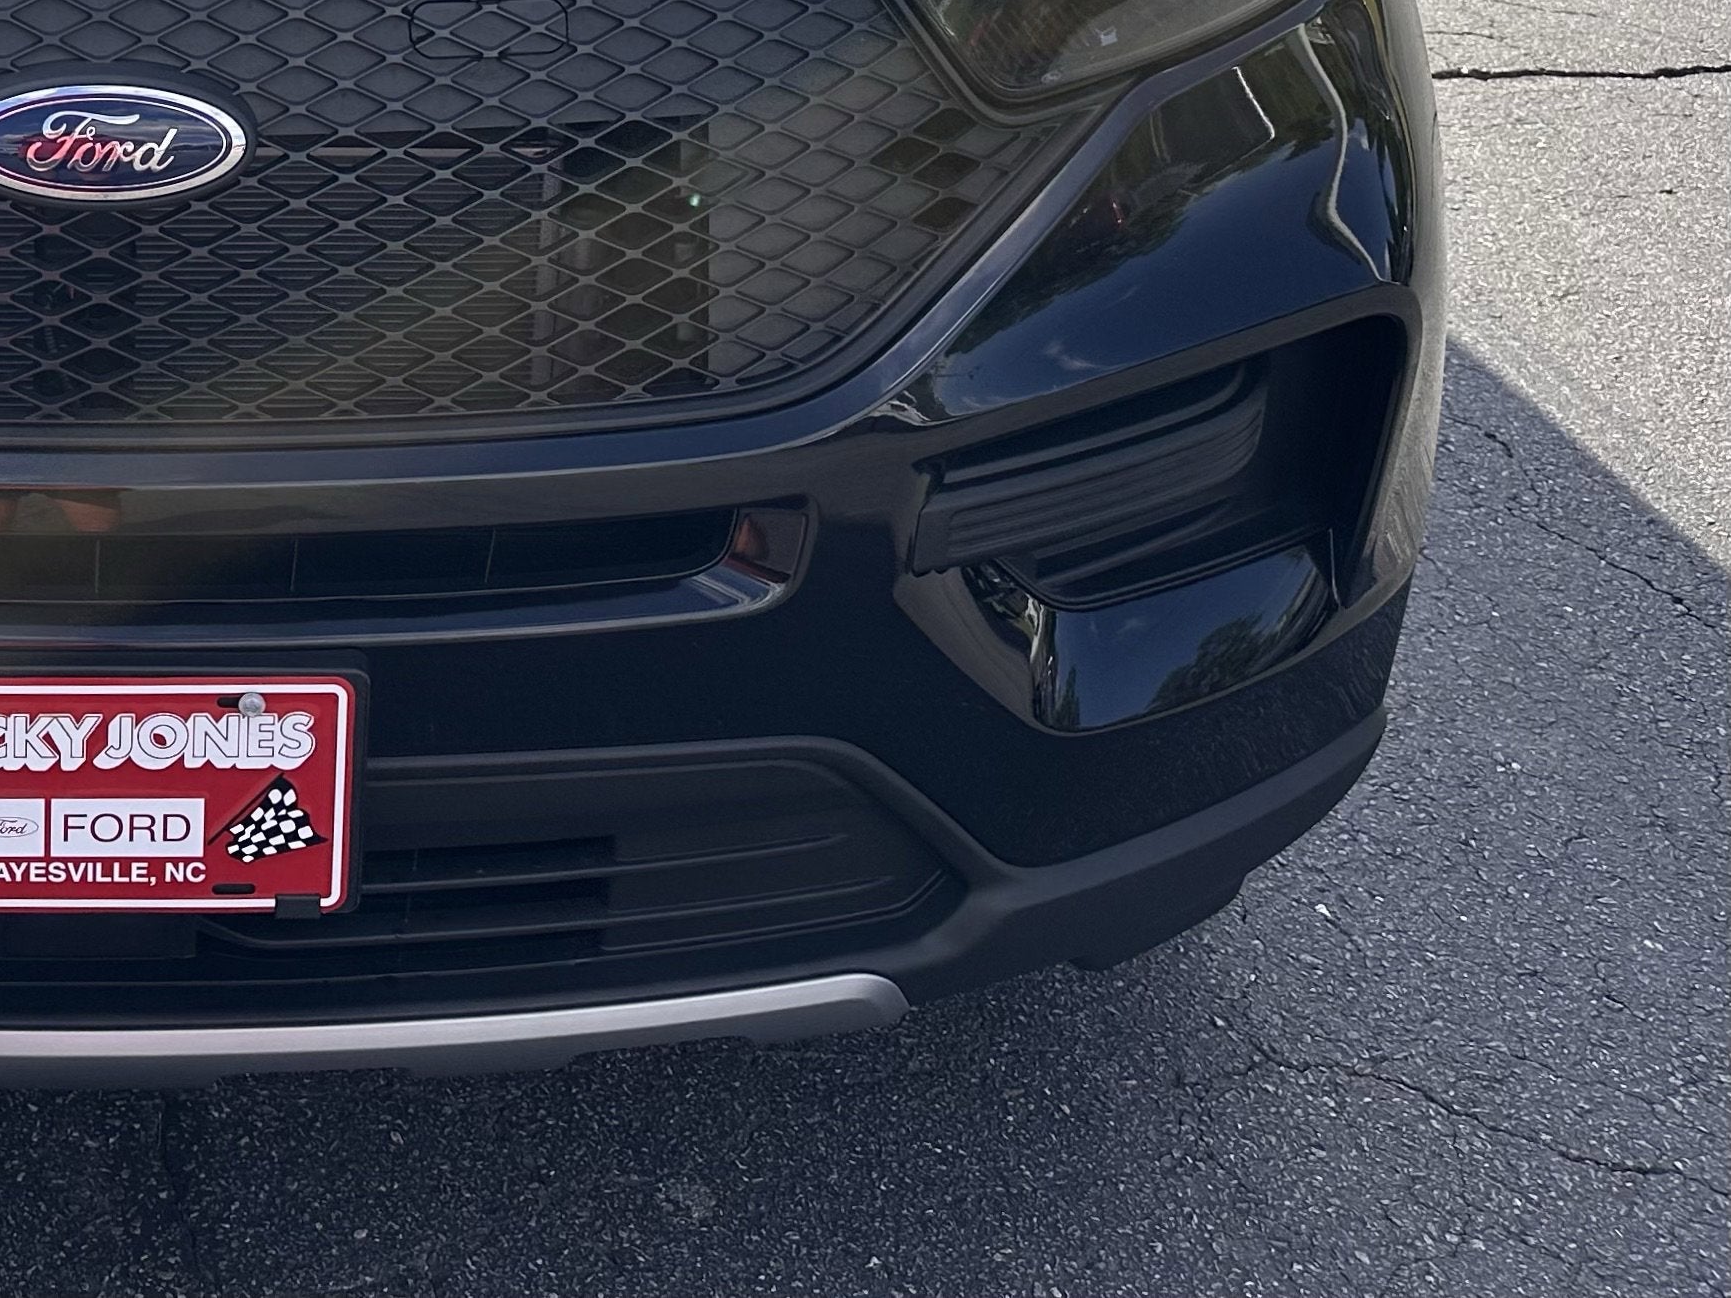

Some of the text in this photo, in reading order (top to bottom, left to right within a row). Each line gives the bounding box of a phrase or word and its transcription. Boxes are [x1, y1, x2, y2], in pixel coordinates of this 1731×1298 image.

[26, 110, 178, 172] Ford
[92, 710, 317, 773] JONES
[62, 813, 192, 844] FORD
[164, 861, 207, 884] NC
